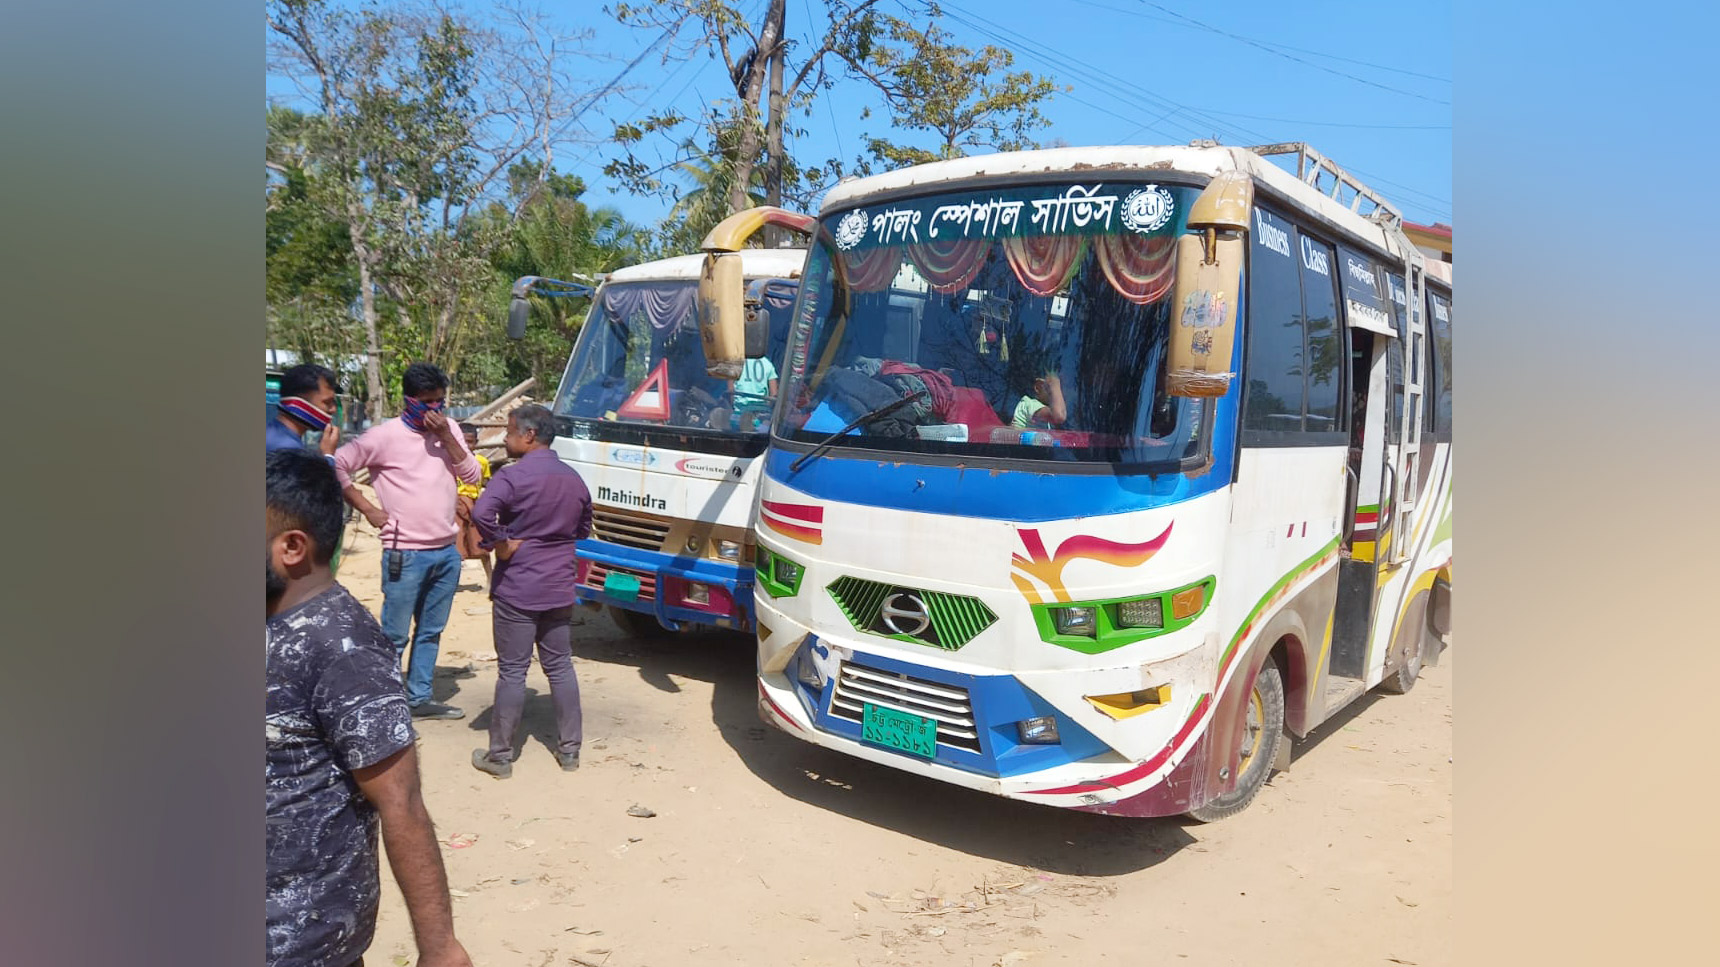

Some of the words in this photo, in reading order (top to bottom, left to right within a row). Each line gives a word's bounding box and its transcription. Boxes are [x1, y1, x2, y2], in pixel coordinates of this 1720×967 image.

[872, 207, 921, 244] পালং
[929, 197, 1024, 238] স্পেশাল
[1031, 184, 1118, 234] সার্ভিস
[1254, 206, 1290, 257] Business
[1301, 235, 1328, 276] Class
[744, 358, 765, 382] 10
[686, 463, 729, 474] tourister
[597, 486, 667, 510] Mahindra
